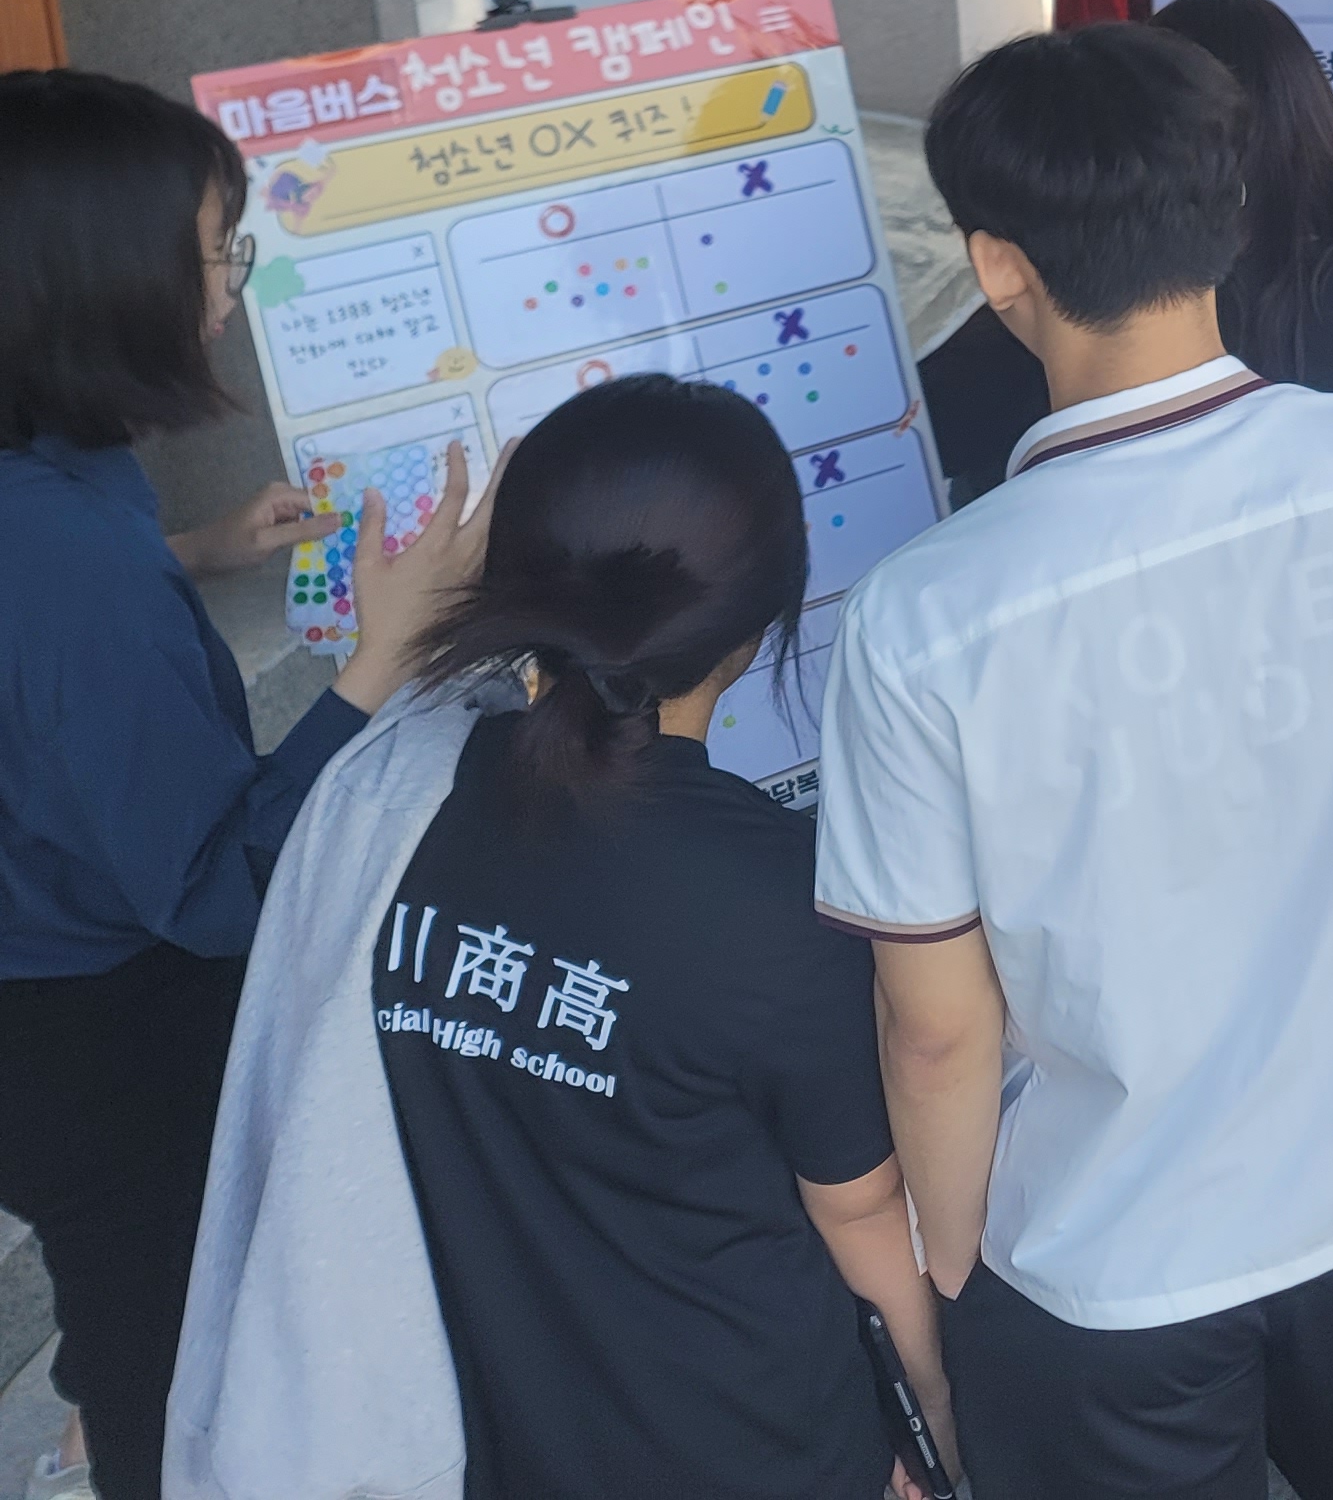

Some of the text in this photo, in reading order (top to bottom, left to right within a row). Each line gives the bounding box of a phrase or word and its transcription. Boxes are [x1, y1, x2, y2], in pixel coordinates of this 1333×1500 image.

[402, 34, 555, 113] 청소년
[567, 2, 737, 82] 캠페인
[410, 131, 516, 187] 청소년
[528, 118, 597, 158] OX
[431, 1016, 502, 1062] High
[509, 1046, 617, 1098] school
